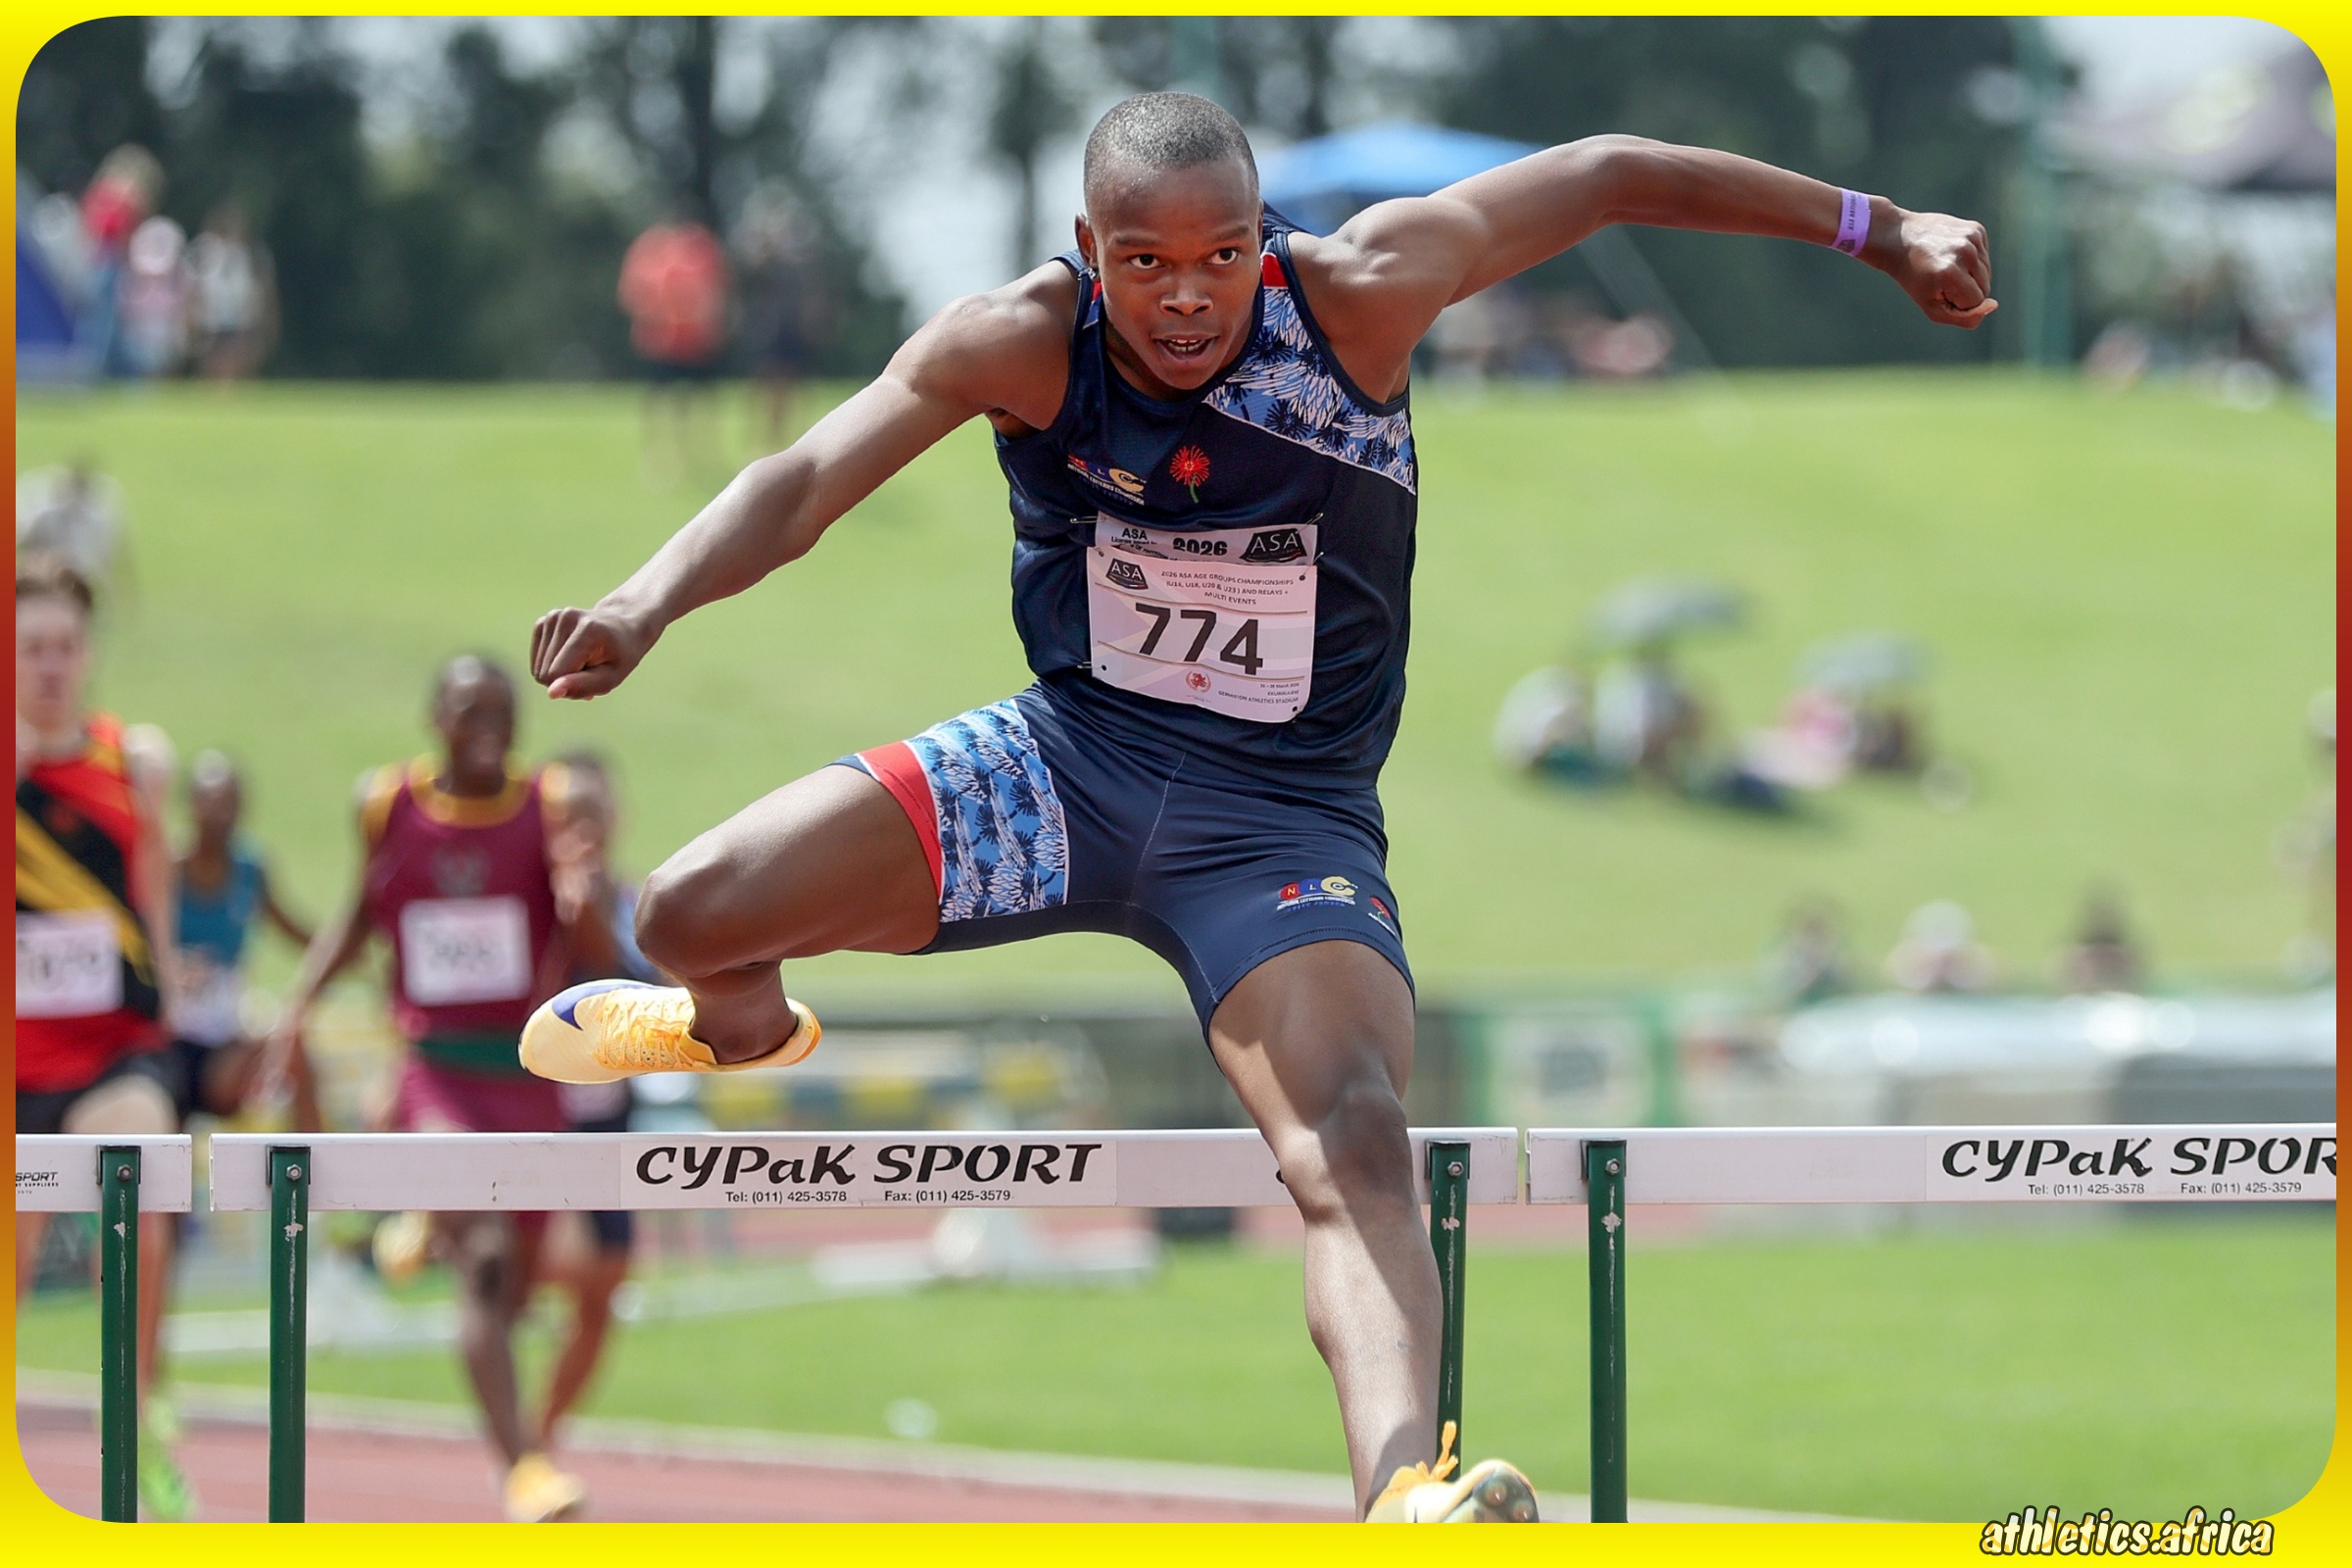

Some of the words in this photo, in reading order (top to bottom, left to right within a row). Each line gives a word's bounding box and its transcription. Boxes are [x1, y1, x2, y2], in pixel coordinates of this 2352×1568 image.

[1122, 528, 1148, 540] ASA
[1173, 537, 1228, 556] 2026
[1250, 532, 1298, 554] ASA
[1111, 562, 1143, 580] ASA
[1208, 573, 1236, 583] GROUPS
[1237, 577, 1294, 586] CHAMPIONSHIPS
[1204, 591, 1227, 601] MULTI
[1228, 596, 1256, 605] EVENTS
[1135, 602, 1263, 675] 774
[1218, 690, 1248, 701] GERMISTON
[874, 1145, 1102, 1185] SPORT
[16, 1171, 58, 1181] SPORT
[2028, 1184, 2049, 1195] Tel:
[2053, 1184, 2082, 1196] (011)
[2087, 1184, 2144, 1194] 425-3578
[2180, 1183, 2206, 1194] Fax:
[2211, 1183, 2240, 1195] (011)
[2245, 1182, 2301, 1193] 425-3579
[725, 1192, 748, 1202] Tel:
[752, 1192, 783, 1204] (011)
[787, 1192, 847, 1201] 425-3578
[884, 1191, 911, 1201] Fax:
[915, 1191, 948, 1203] (011)
[951, 1190, 1010, 1200] 425-3579
